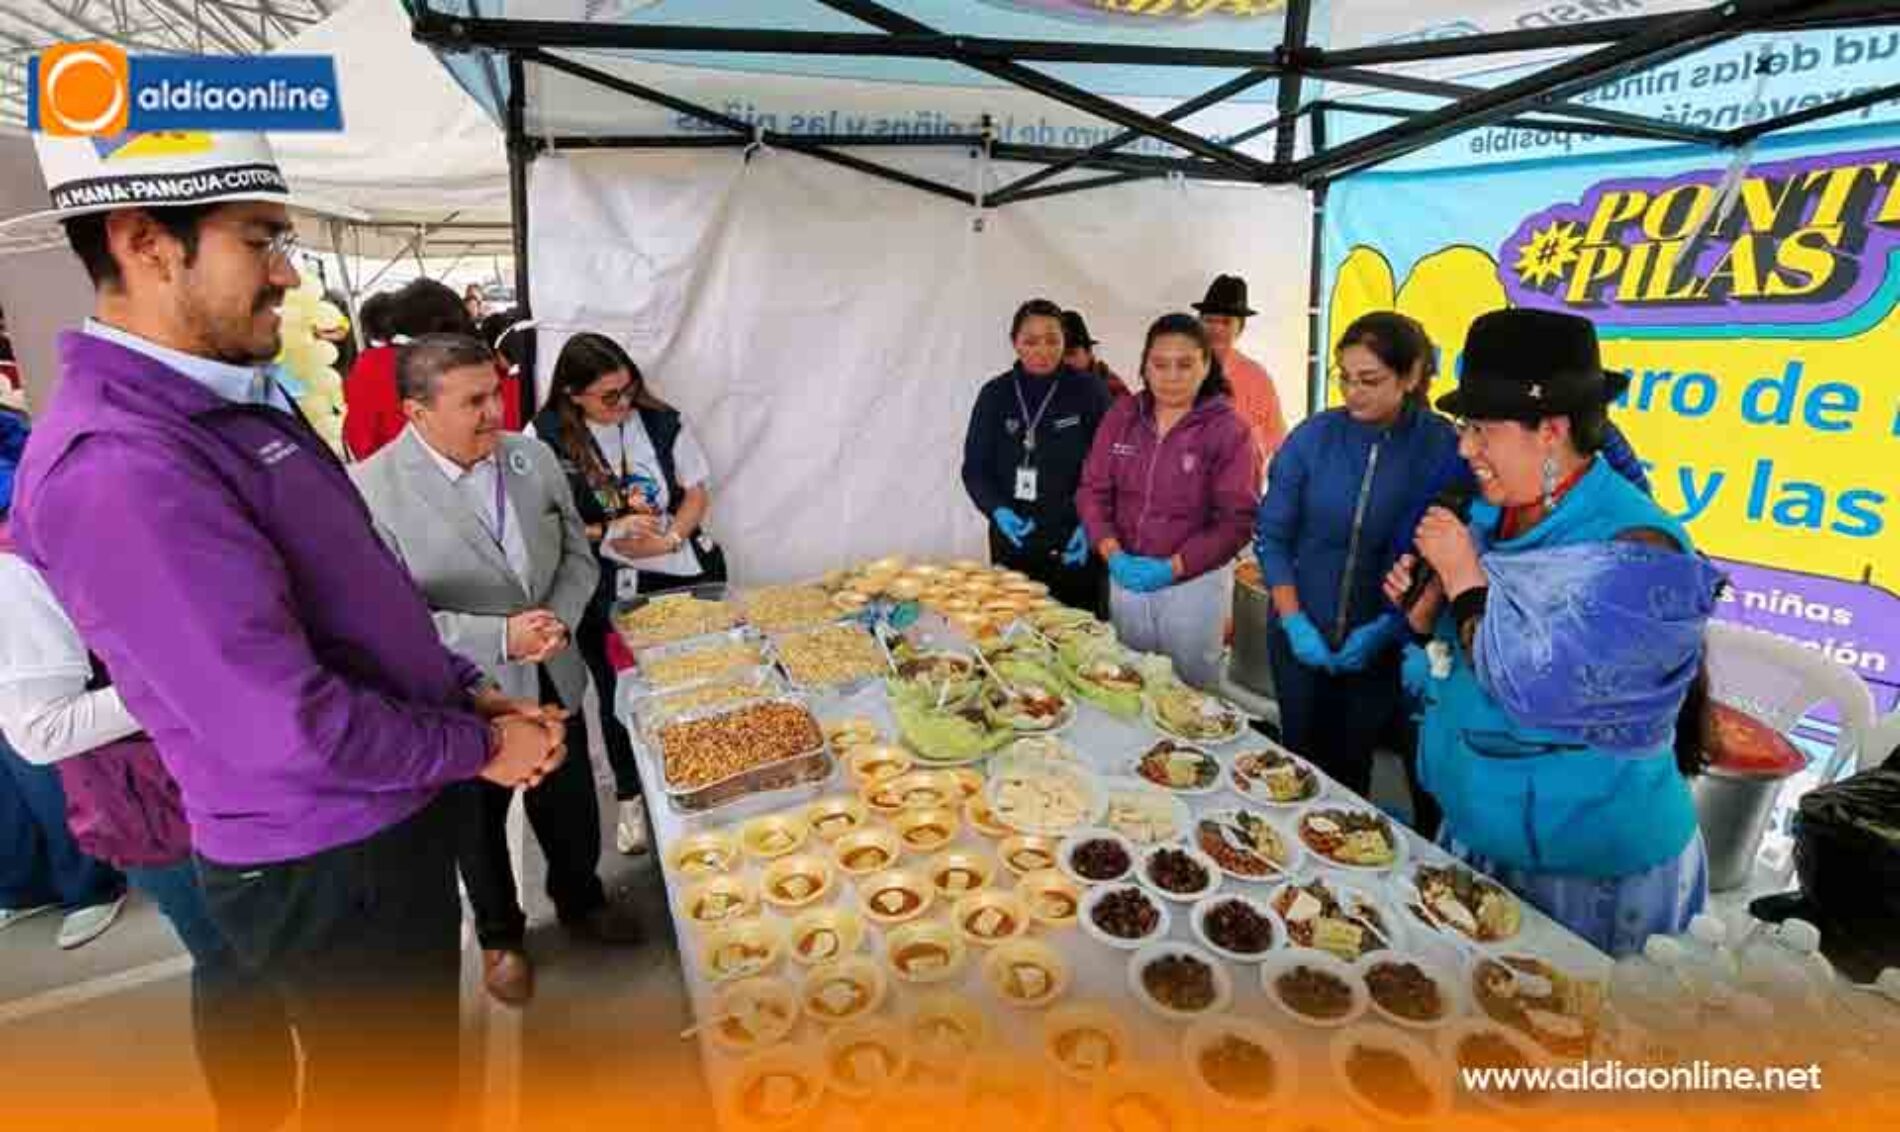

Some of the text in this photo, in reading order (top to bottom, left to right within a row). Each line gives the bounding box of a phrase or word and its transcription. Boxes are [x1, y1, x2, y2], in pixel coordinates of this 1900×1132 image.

[1566, 225, 1845, 303] PILAS
[1740, 360, 1862, 433] de
[1677, 457, 1888, 539] y las
[1742, 588, 1854, 626] niñas
